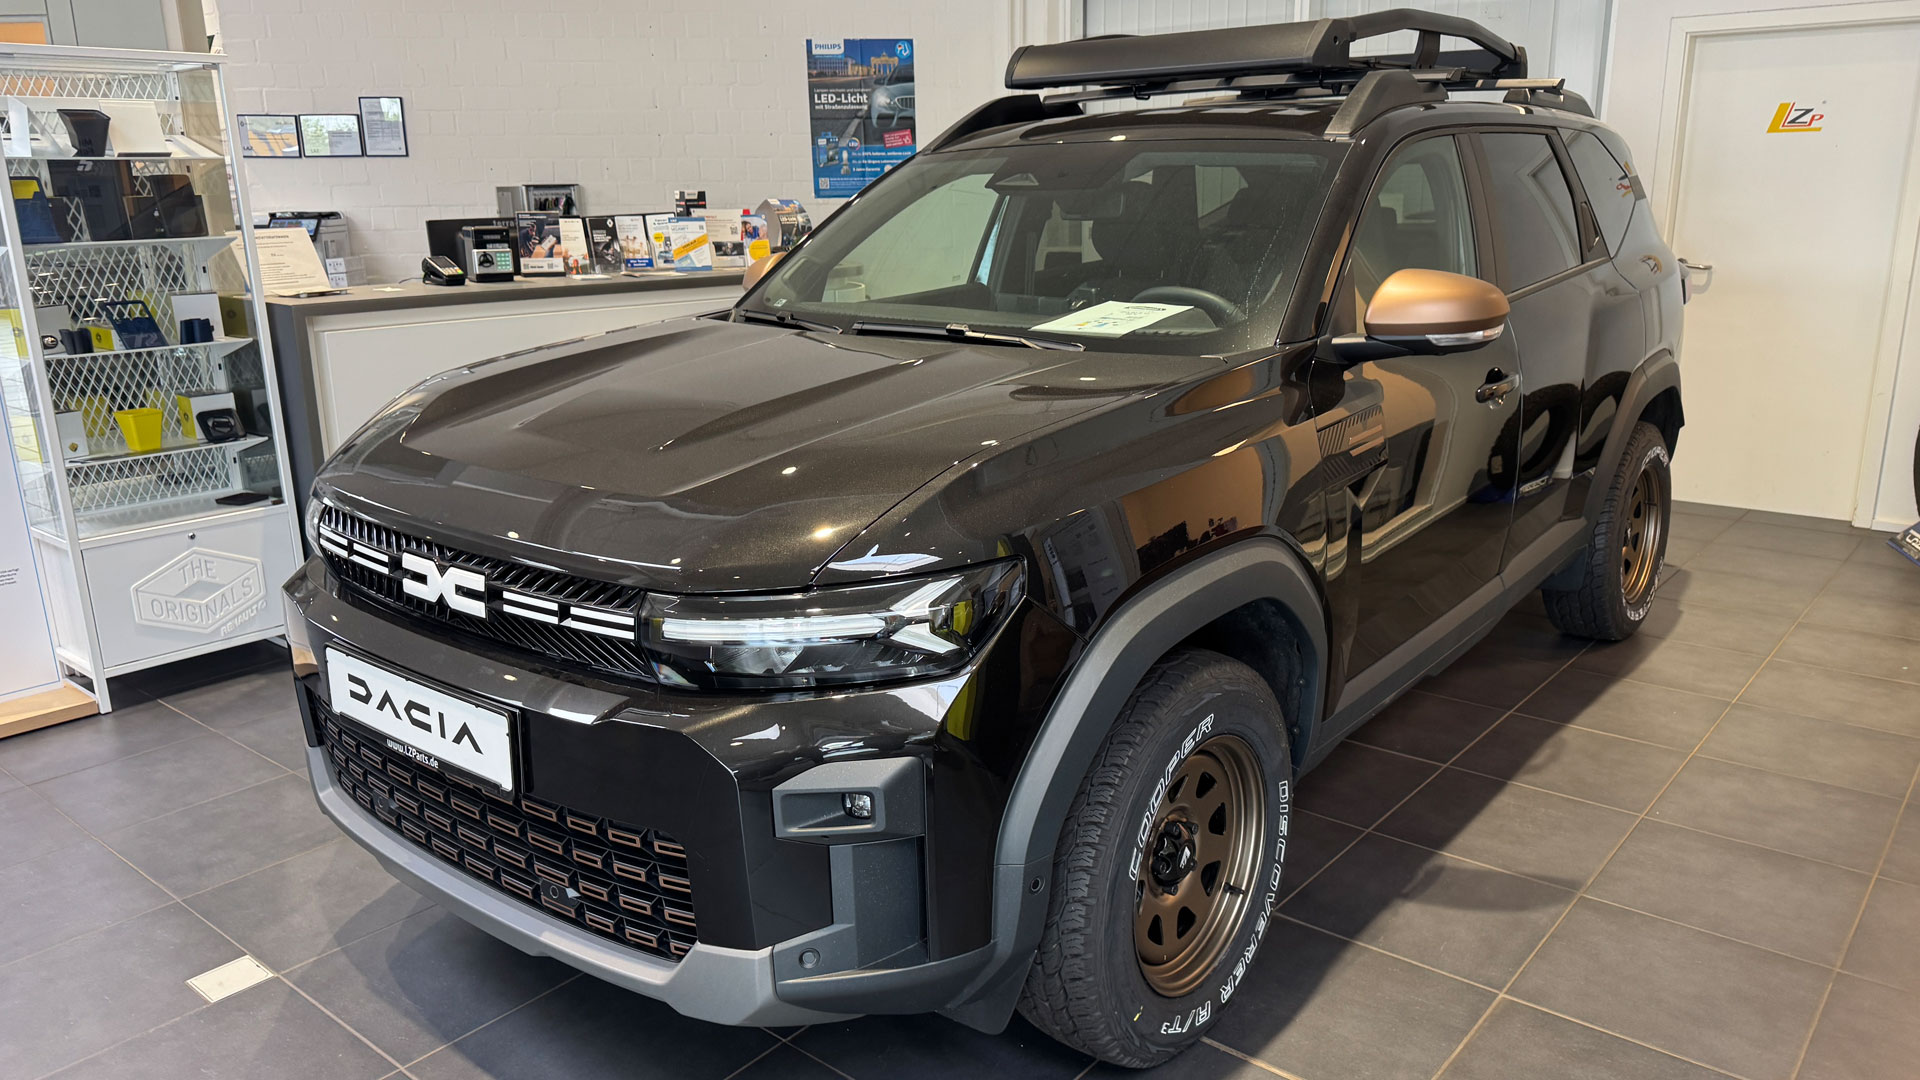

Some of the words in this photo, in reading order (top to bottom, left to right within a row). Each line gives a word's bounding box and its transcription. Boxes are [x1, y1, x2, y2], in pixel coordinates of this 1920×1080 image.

[814, 93, 868, 104] LED-Licht
[178, 558, 219, 586] THE
[151, 576, 254, 625] ORIGINALS
[347, 673, 484, 756] DACIA
[386, 738, 439, 769] www.LZParts.de
[1128, 713, 1214, 881] COOPER
[1219, 780, 1288, 1004] DISCOVERER
